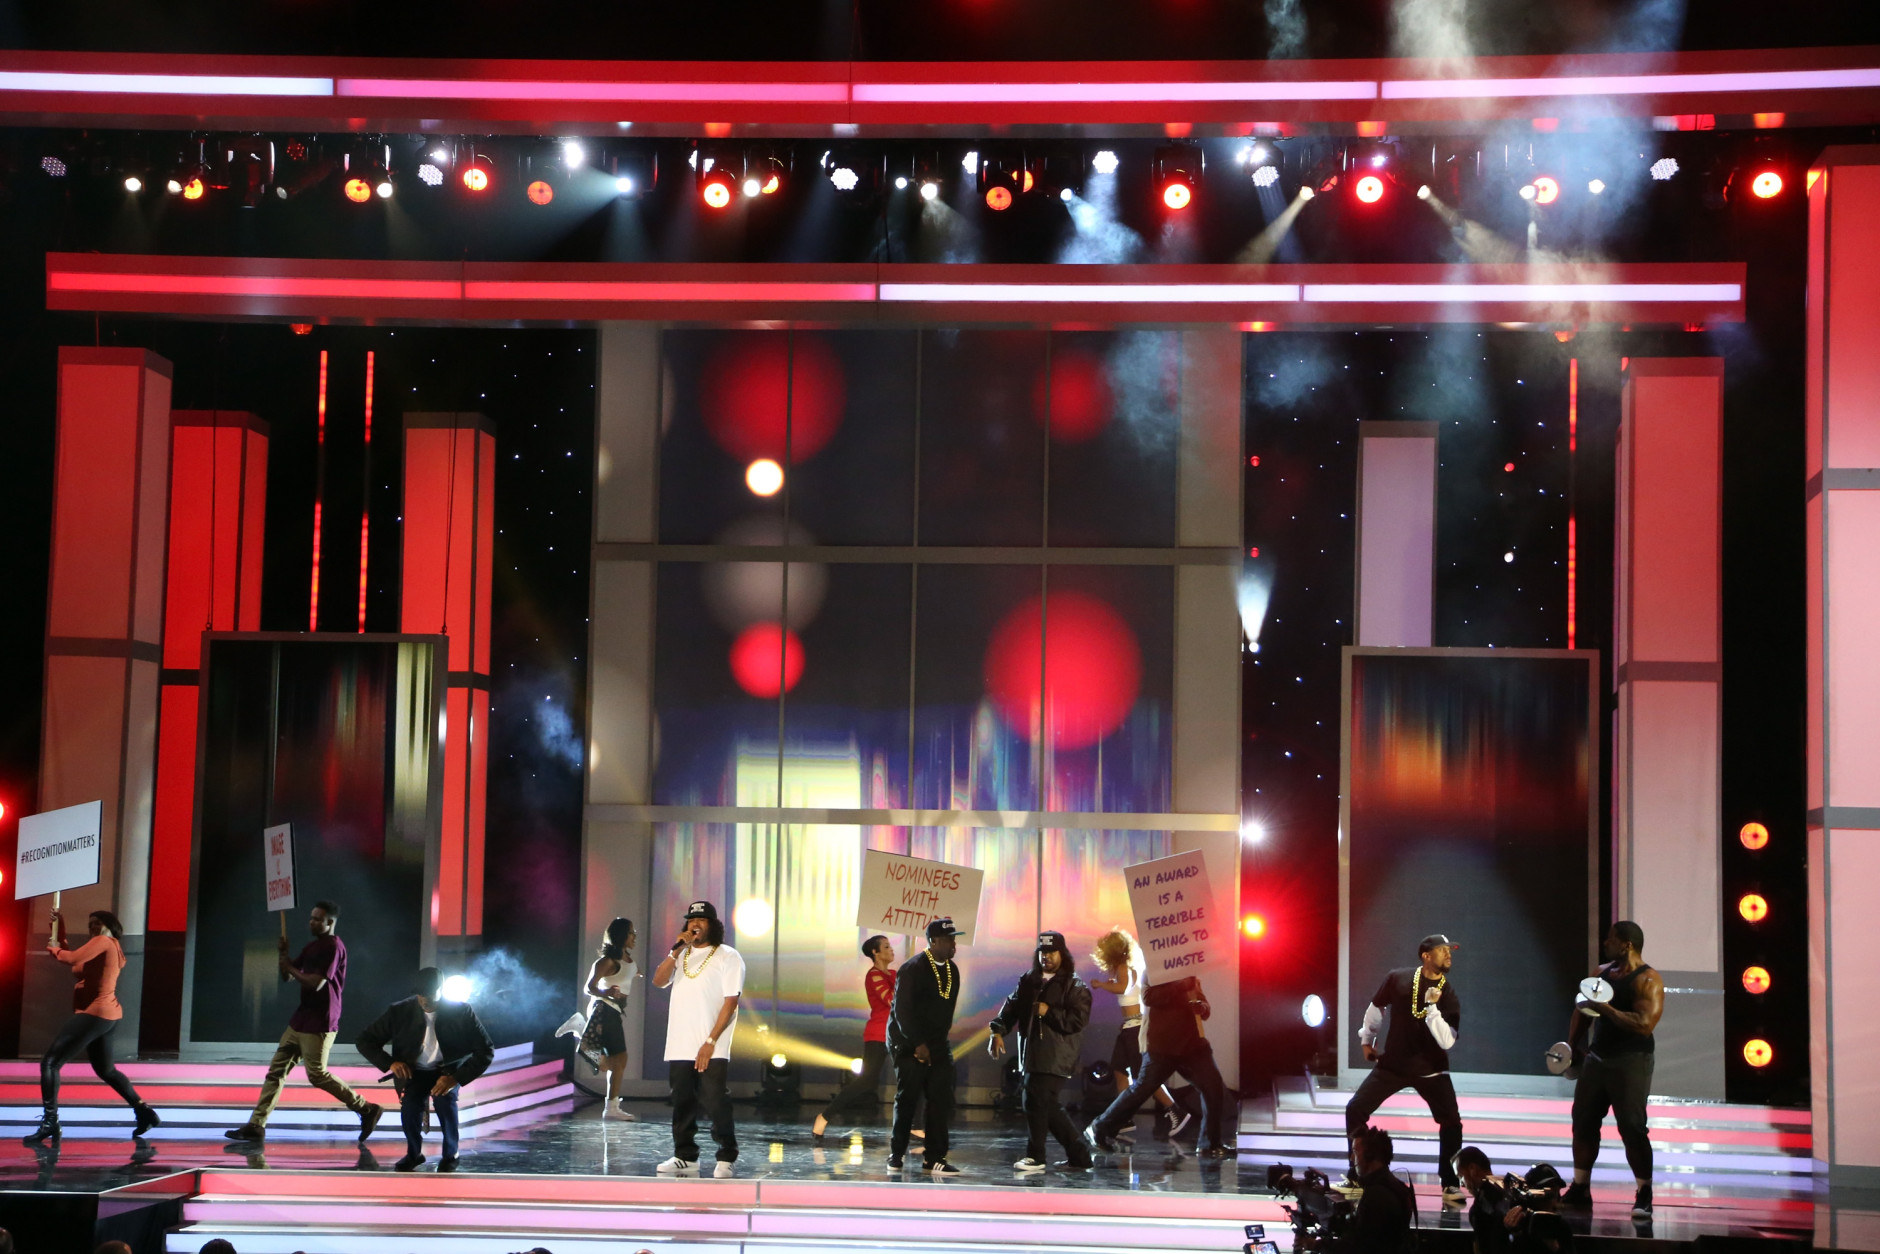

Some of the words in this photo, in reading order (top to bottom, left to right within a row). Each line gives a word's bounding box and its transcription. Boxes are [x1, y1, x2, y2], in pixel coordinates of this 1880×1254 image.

[21, 834, 95, 864] #RECOGNITIONMATTERS
[885, 861, 961, 890] NOMINEES
[1134, 875, 1150, 889] AN
[1155, 865, 1199, 885] AWARD
[902, 887, 939, 911] WITH
[1158, 892, 1170, 906] IS
[1175, 890, 1184, 902] A
[881, 905, 952, 930] ATTITU
[1145, 907, 1205, 930] TERRIBLE
[1149, 933, 1188, 951] THING
[1192, 928, 1209, 942] TO
[1163, 951, 1206, 970] WASTE
